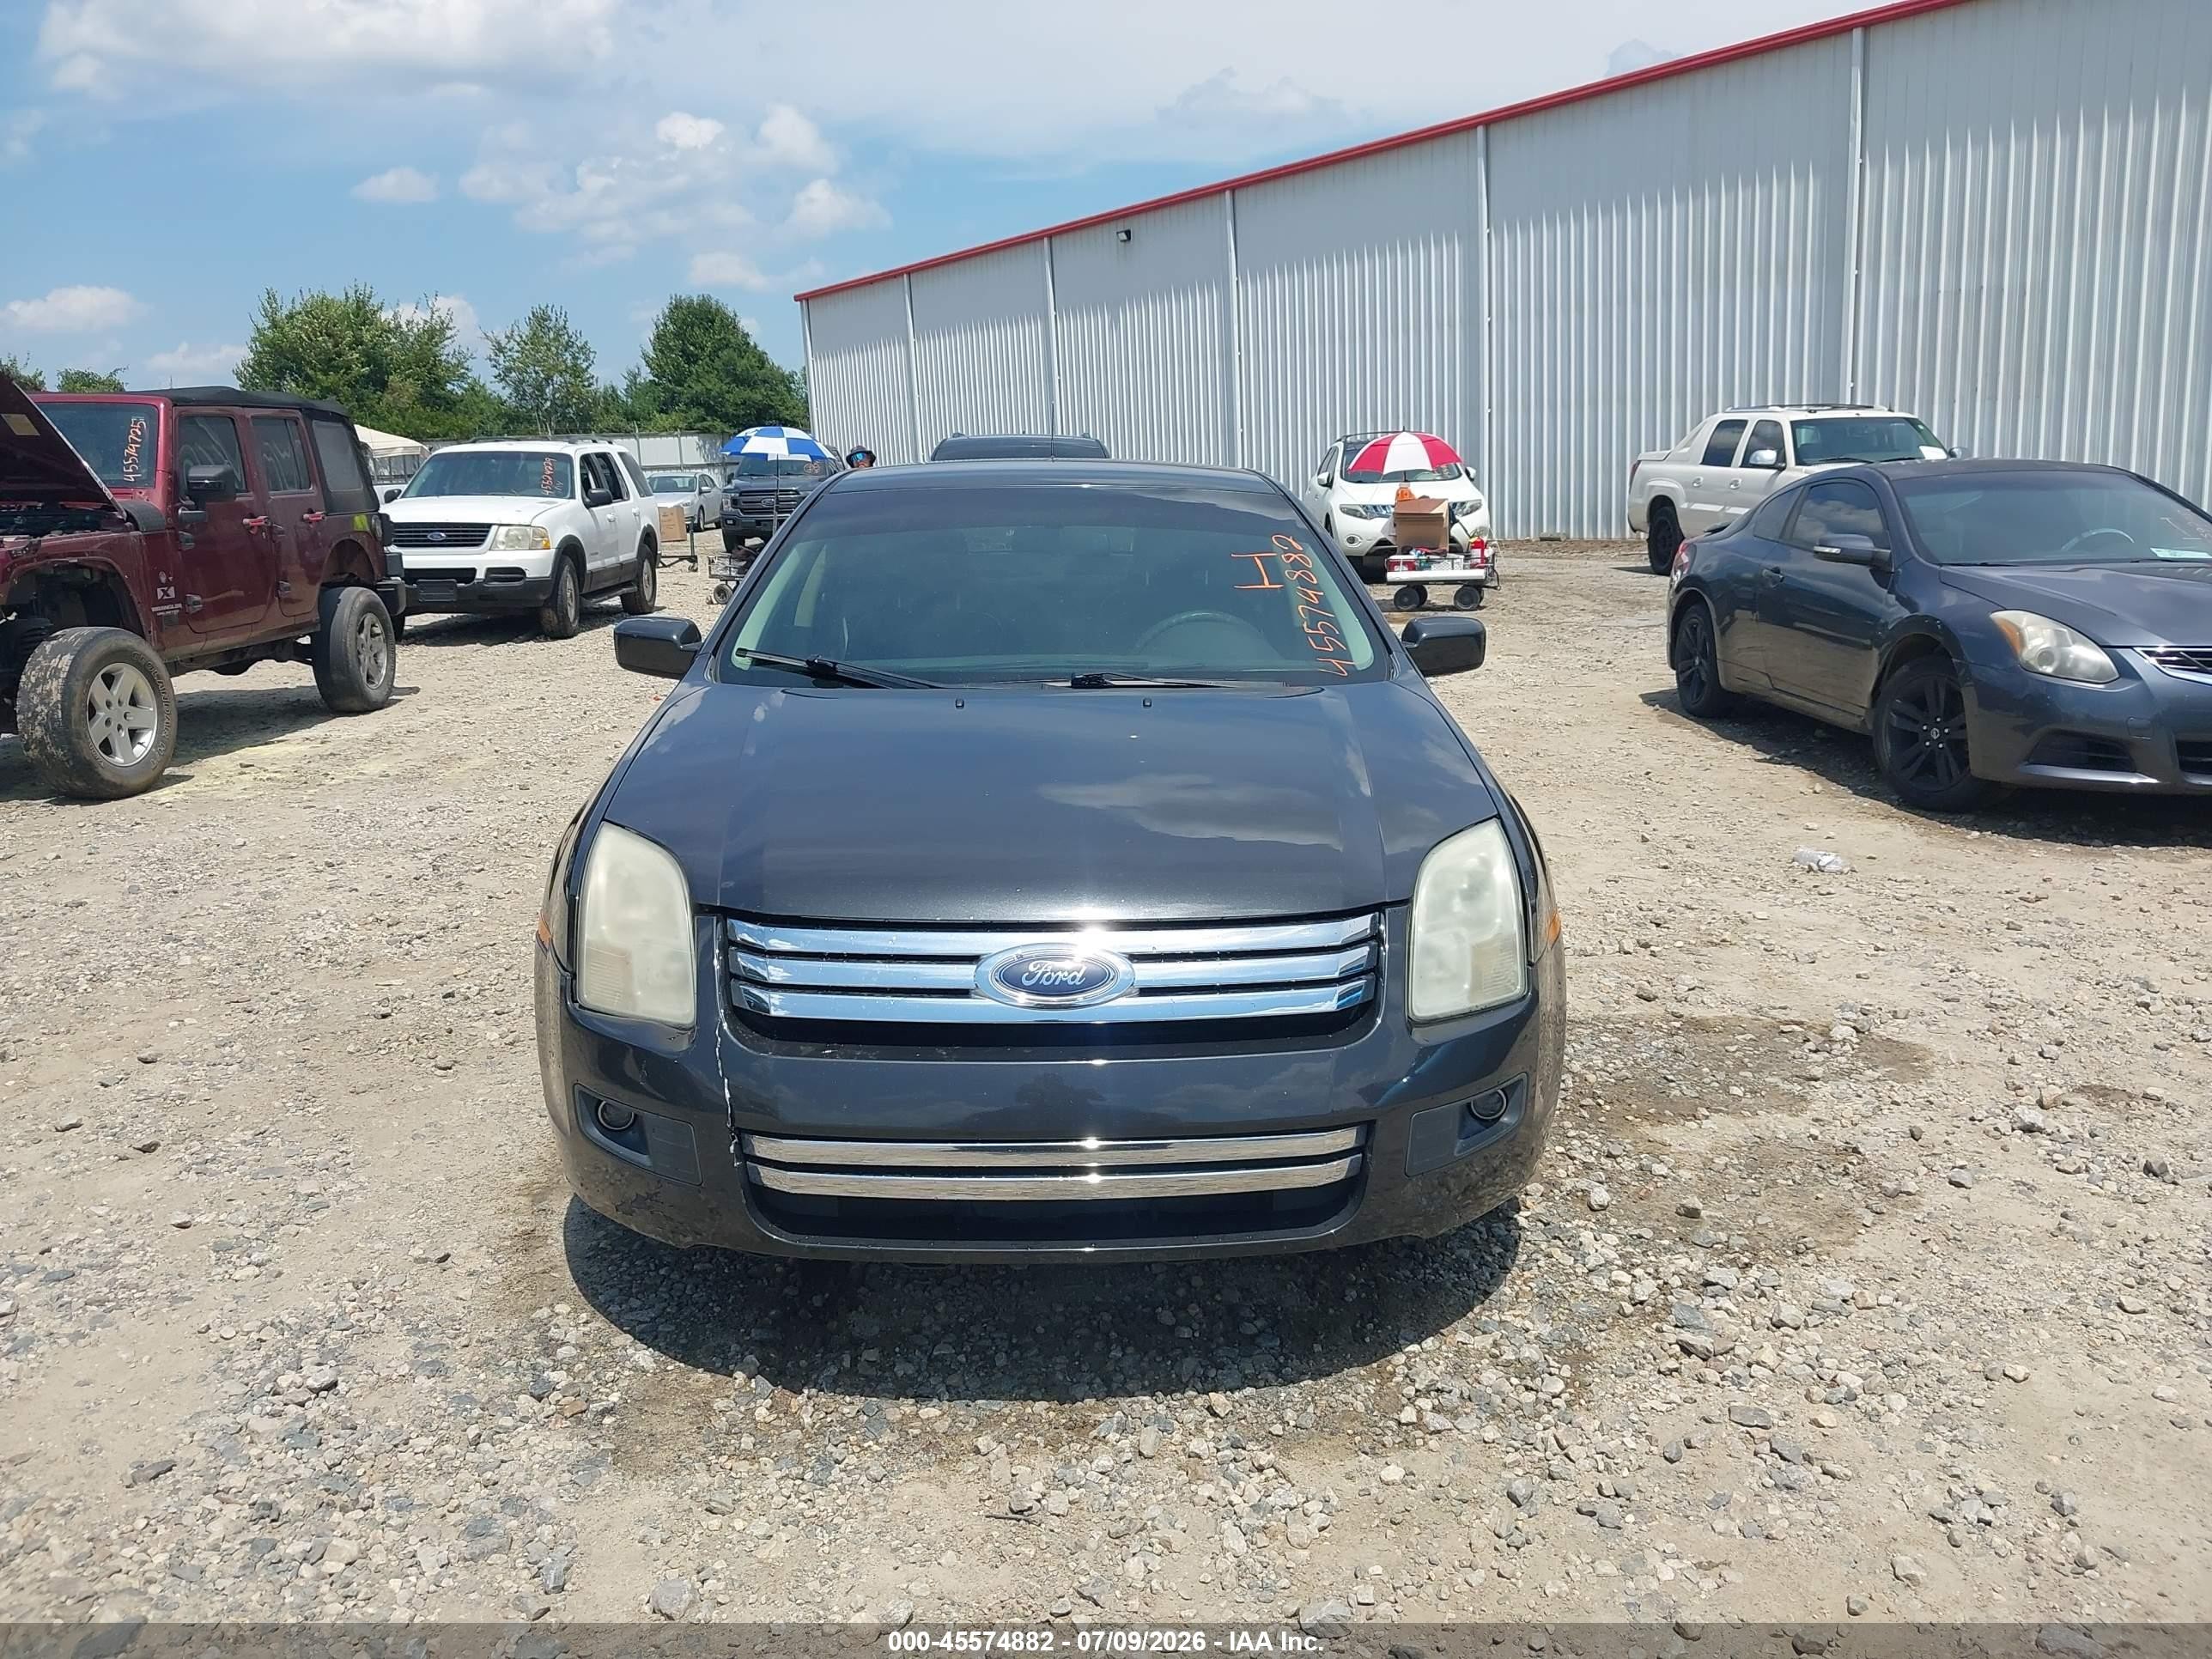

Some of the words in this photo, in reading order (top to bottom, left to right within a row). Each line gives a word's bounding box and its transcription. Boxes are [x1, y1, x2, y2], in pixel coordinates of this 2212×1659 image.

[123, 418, 146, 482] 45574725
[1231, 552, 1285, 589] H
[1271, 534, 1358, 677] 45574882
[1021, 960, 1086, 987] Ford
